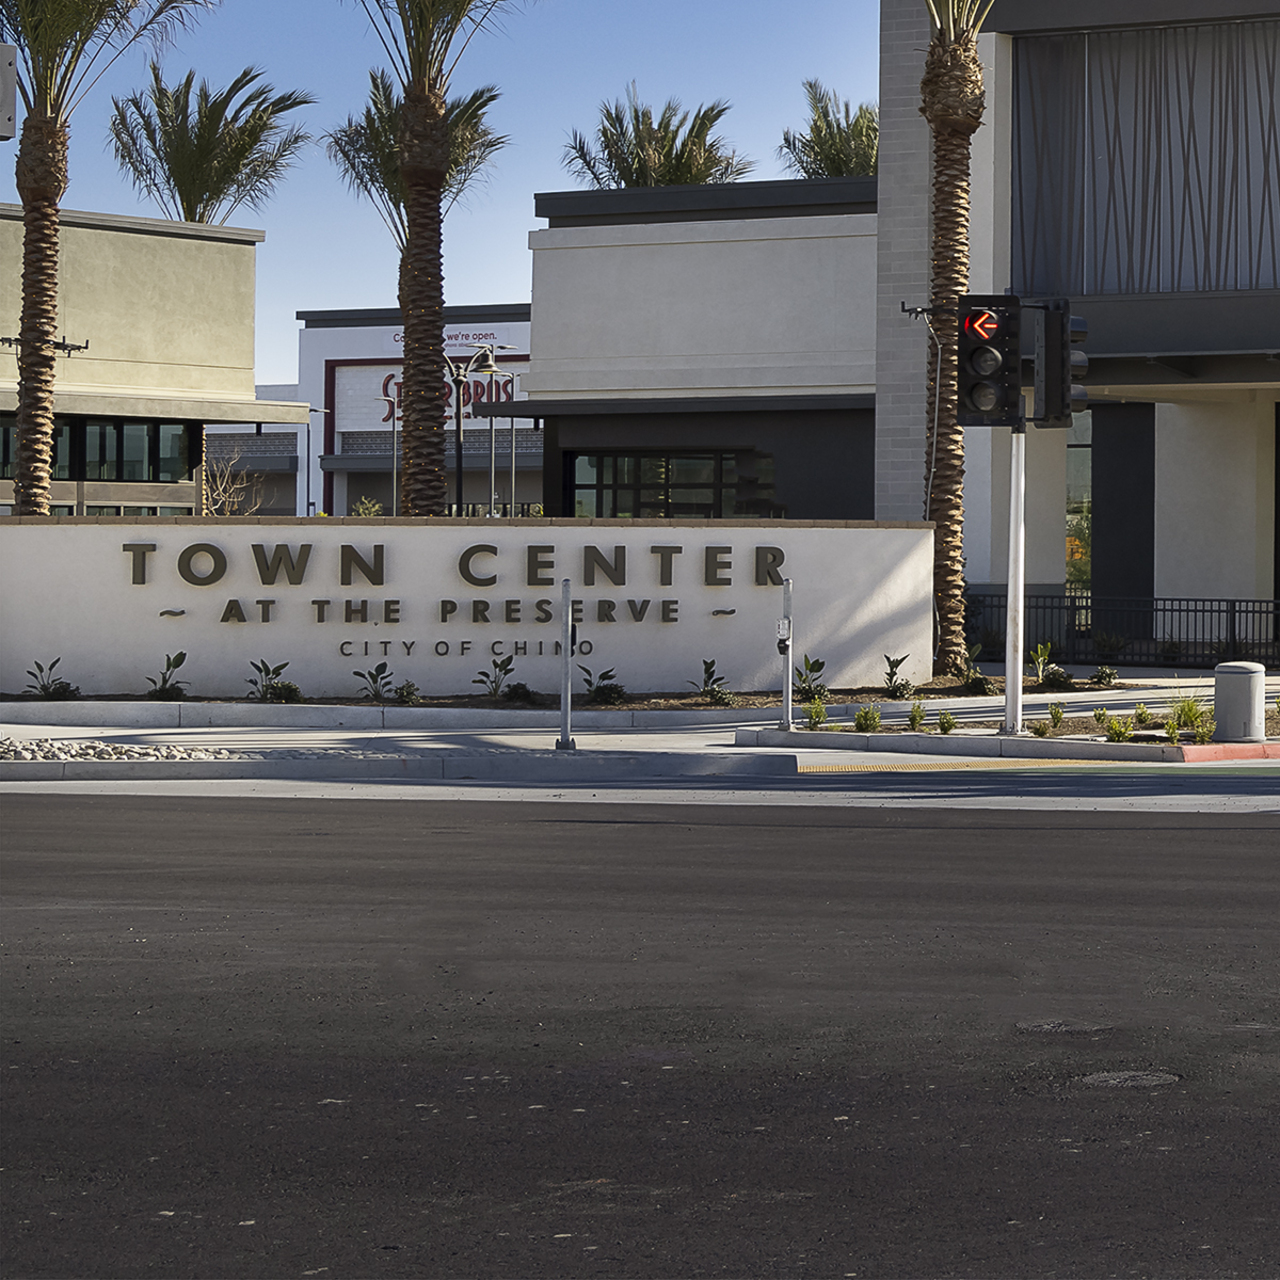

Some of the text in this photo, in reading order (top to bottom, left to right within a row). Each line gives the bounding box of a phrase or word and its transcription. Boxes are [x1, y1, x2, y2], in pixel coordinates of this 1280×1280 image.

[446, 331, 470, 341] we're
[472, 332, 497, 342] open.
[122, 543, 786, 587] TOWN CENTER
[220, 599, 679, 623] AT THE PRESERVE
[339, 641, 416, 656] CITY
[434, 640, 472, 656] OF
